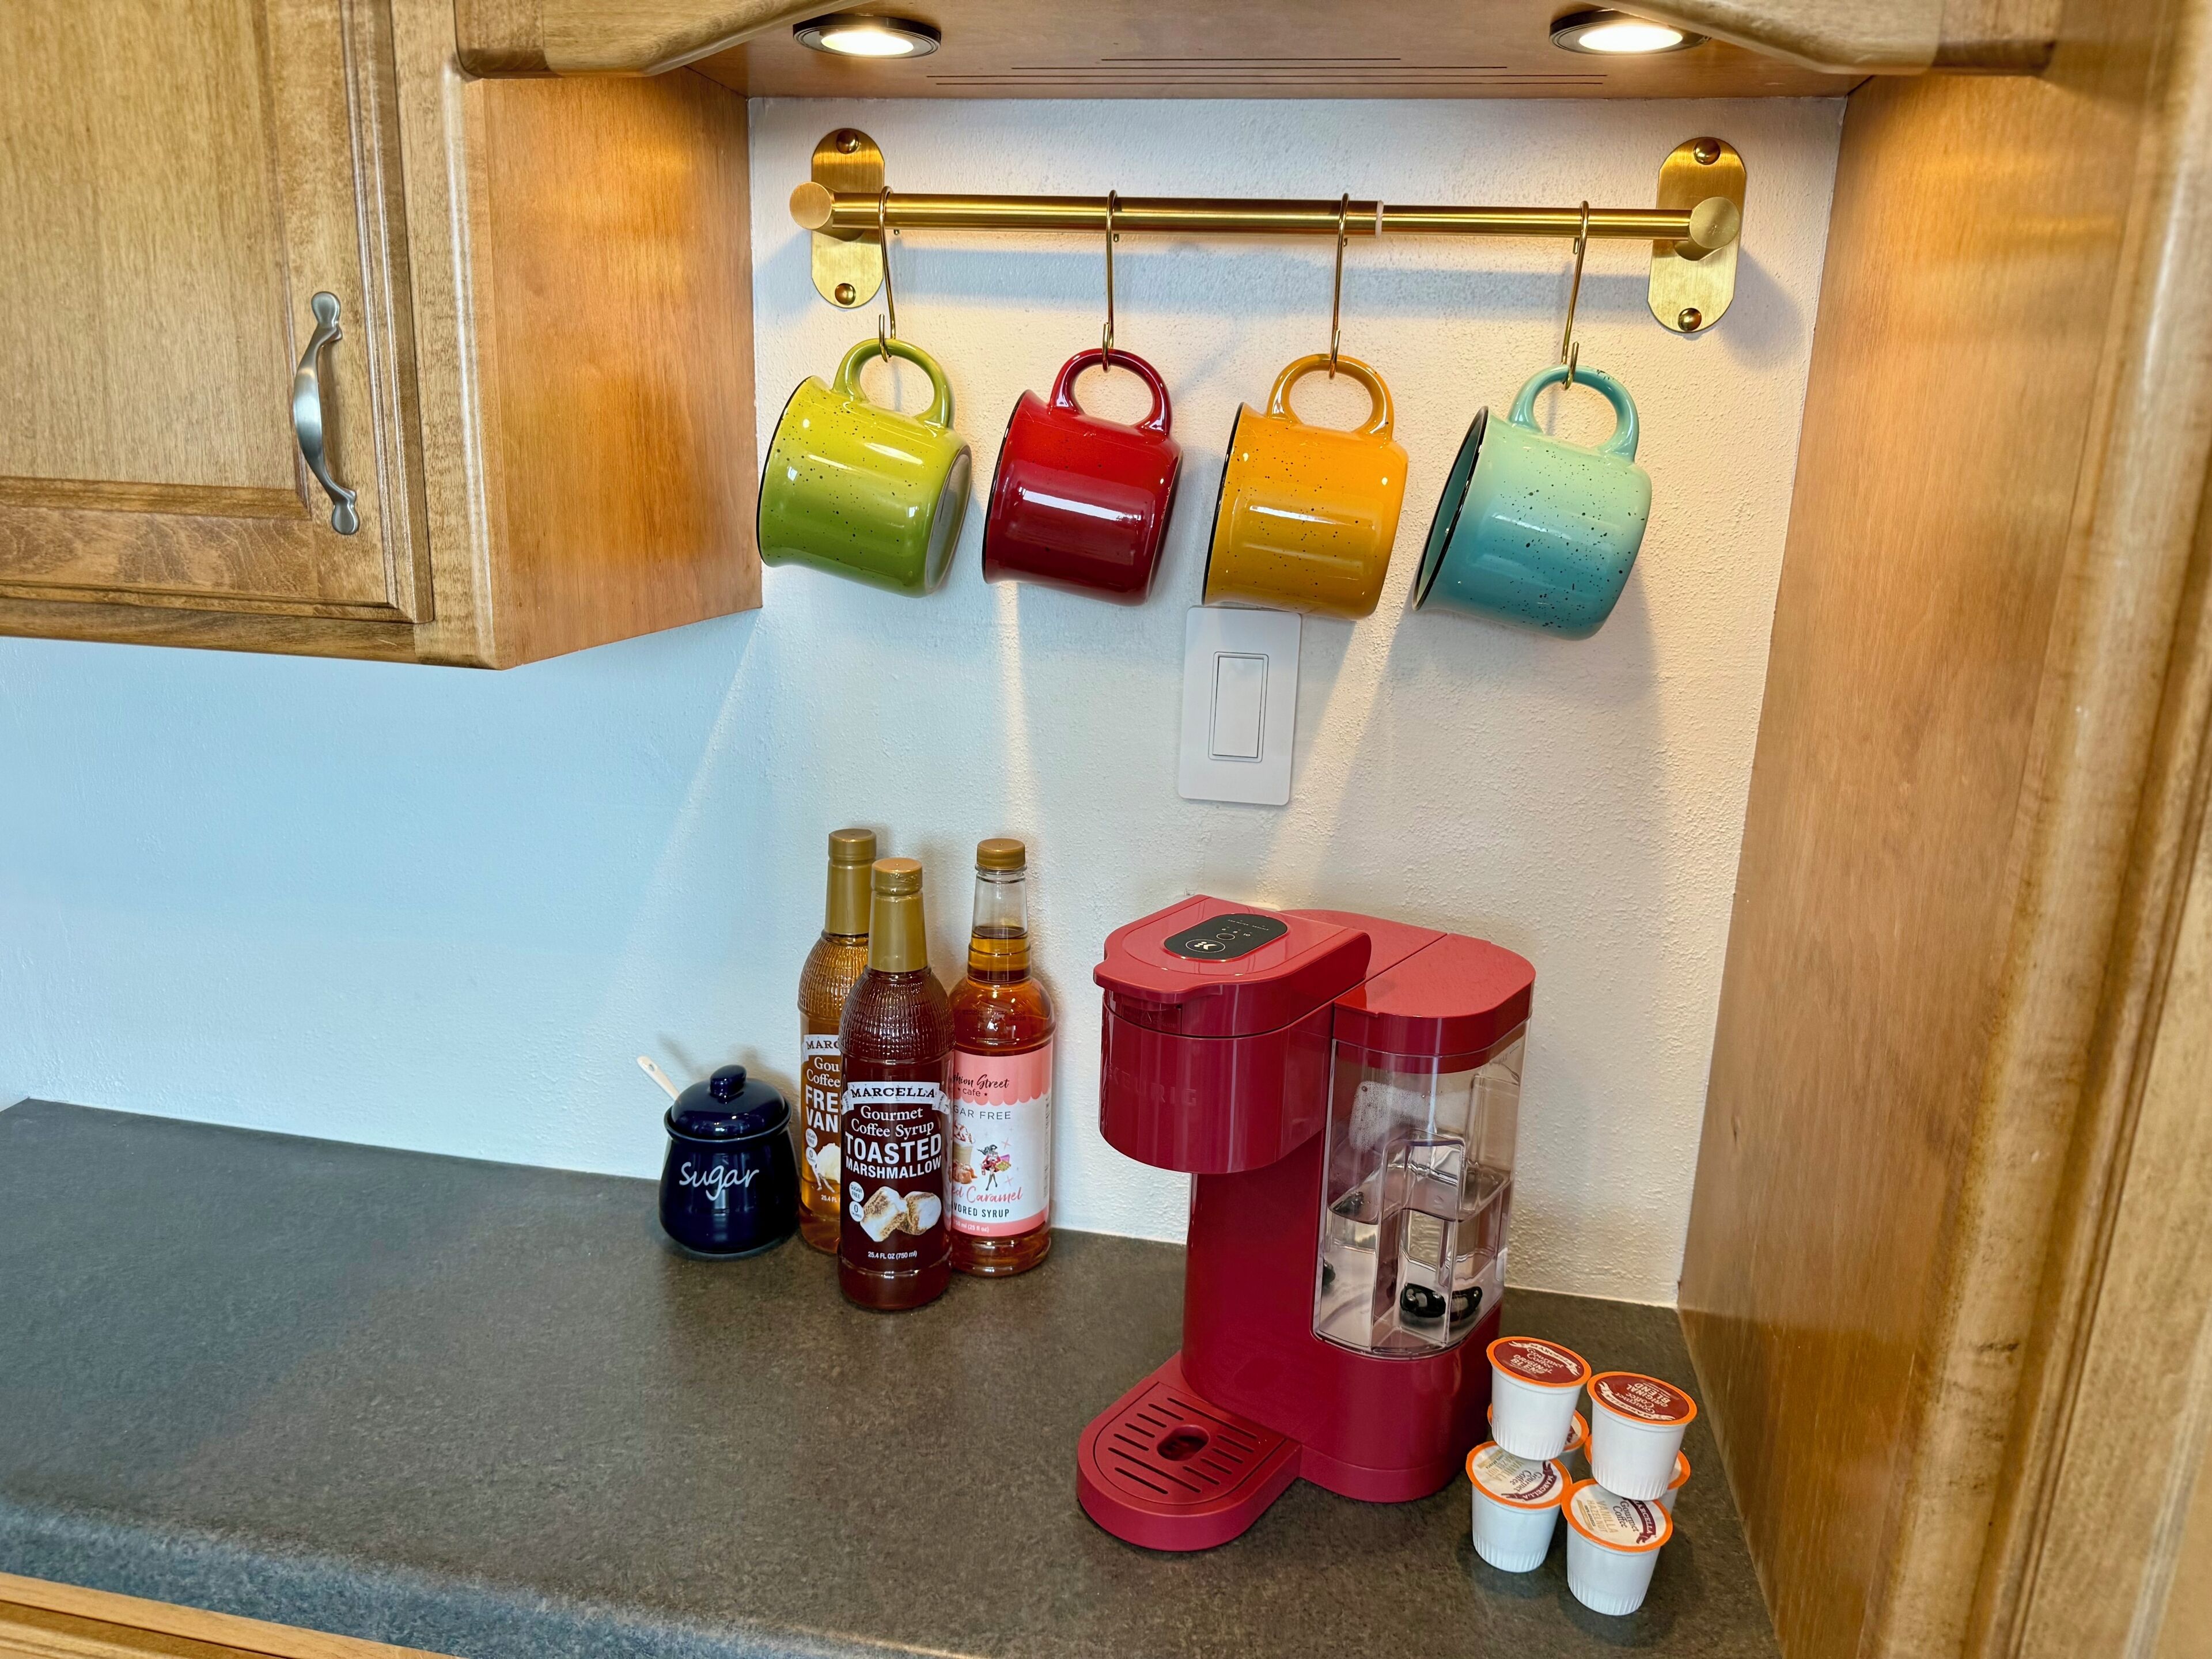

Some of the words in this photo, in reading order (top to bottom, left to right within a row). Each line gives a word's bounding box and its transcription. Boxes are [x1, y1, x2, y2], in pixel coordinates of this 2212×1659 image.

[806, 1069, 841, 1088] Coffee
[977, 1074, 1009, 1089] Street
[805, 1084, 839, 1113] FRE
[851, 1088, 935, 1098] MARCELLA
[963, 1088, 981, 1097] cafe
[805, 1106, 839, 1133] VAN
[861, 1105, 923, 1121] Gourmet
[980, 1111, 1011, 1120] FREE
[851, 1118, 891, 1137] Coffee
[895, 1122, 934, 1140] Syrup
[845, 1131, 942, 1165] TOASTED
[846, 1155, 942, 1179] MARSHMALLOW
[679, 1161, 760, 1201] Sugar
[967, 1185, 1023, 1203] Caramel
[854, 1204, 858, 1213] 0
[952, 1200, 978, 1217] VORED
[982, 1209, 1009, 1218] SYRUP
[1510, 1358, 1546, 1374] BLEND
[1513, 1354, 1552, 1374] ORIGINAL
[1626, 1384, 1668, 1407] ORIGINAL
[1634, 1383, 1671, 1403] BLEND
[1510, 1470, 1532, 1485] Coffee
[1514, 1472, 1543, 1492] Gourmet
[1522, 1475, 1555, 1499] MARCELLA
[1586, 1499, 1609, 1533] HAZELNUT
[1596, 1500, 1618, 1533] VANILLA
[1613, 1505, 1628, 1528] Coffee
[1620, 1501, 1639, 1532] Gourmet
